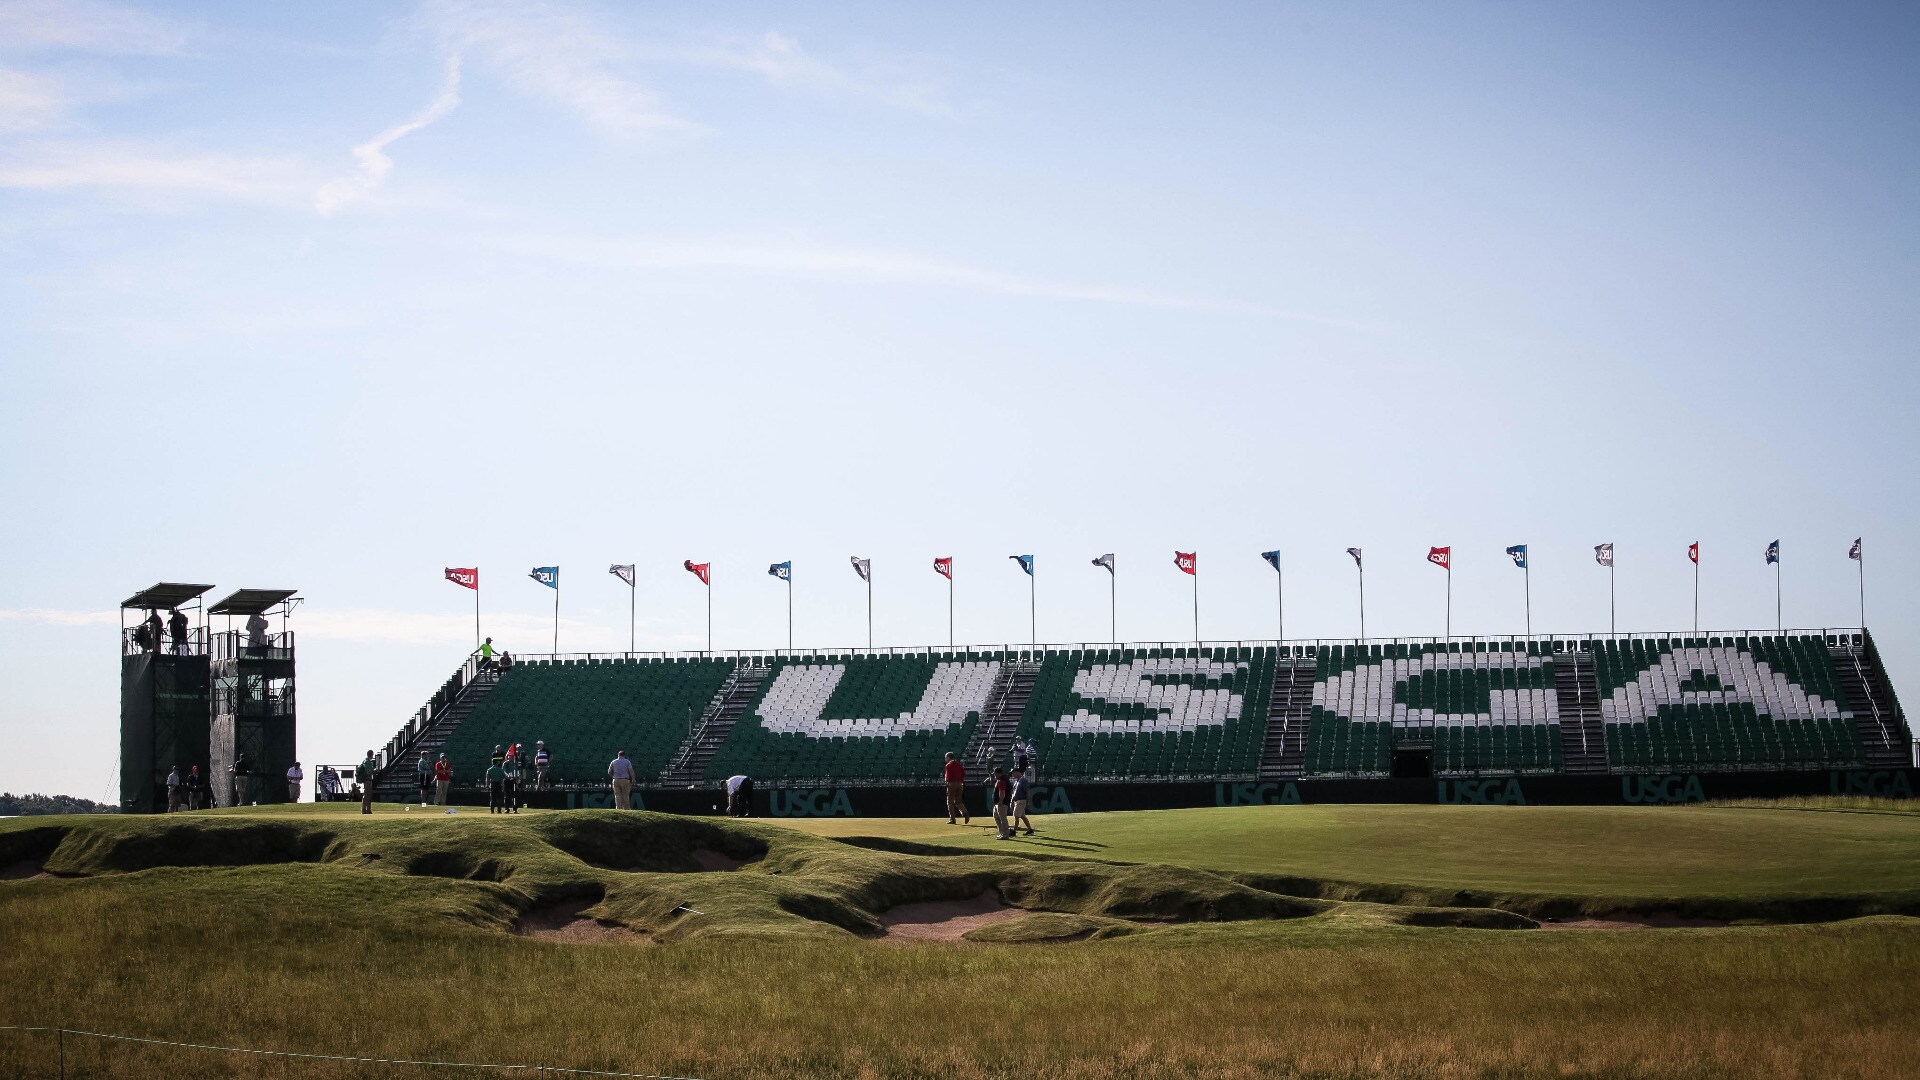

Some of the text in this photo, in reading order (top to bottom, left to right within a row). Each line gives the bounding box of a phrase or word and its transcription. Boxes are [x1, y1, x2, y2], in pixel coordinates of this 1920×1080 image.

[178, 644, 188, 657] 18
[1215, 781, 1302, 806] USGA
[1437, 778, 1526, 805] USGA
[1621, 774, 1705, 803] USGA
[1830, 770, 1916, 797] USGA
[769, 789, 854, 817] USGA
